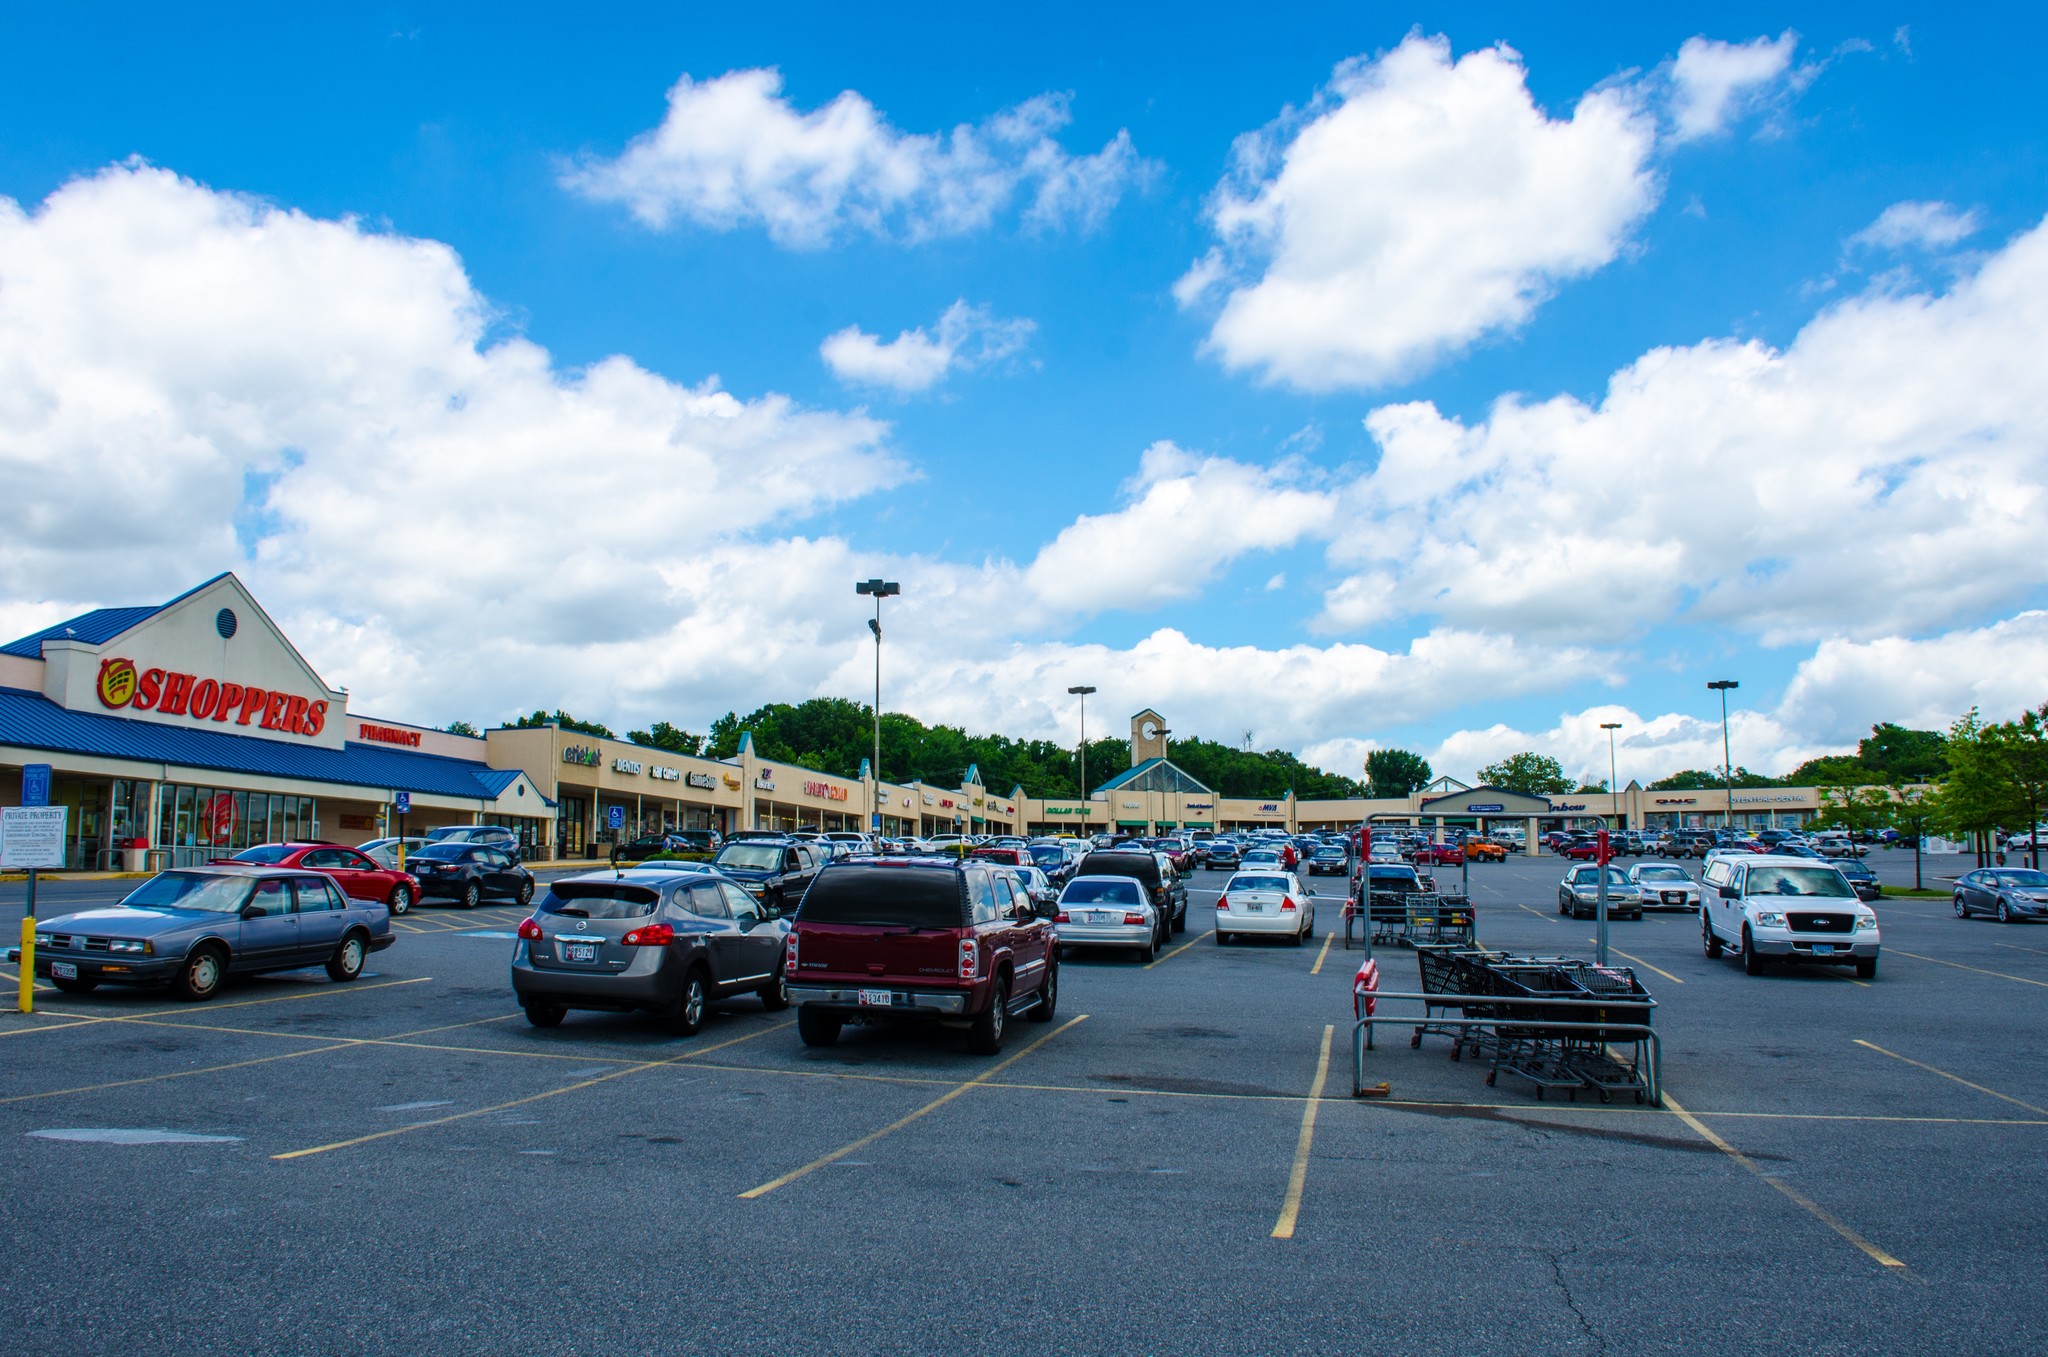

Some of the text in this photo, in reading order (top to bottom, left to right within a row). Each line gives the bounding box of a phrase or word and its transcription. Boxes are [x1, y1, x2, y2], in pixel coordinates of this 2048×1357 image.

[132, 667, 328, 736] SHOPPERS
[360, 723, 422, 747] PHARMACY
[616, 758, 643, 775] DENTIST
[1775, 794, 1807, 802] DENTAL
[1045, 807, 1073, 815] DOLLAR
[1262, 804, 1278, 812] MVA
[4, 811, 62, 820] PRIVATE PROPERTY
[918, 966, 955, 974] CHEVROLET
